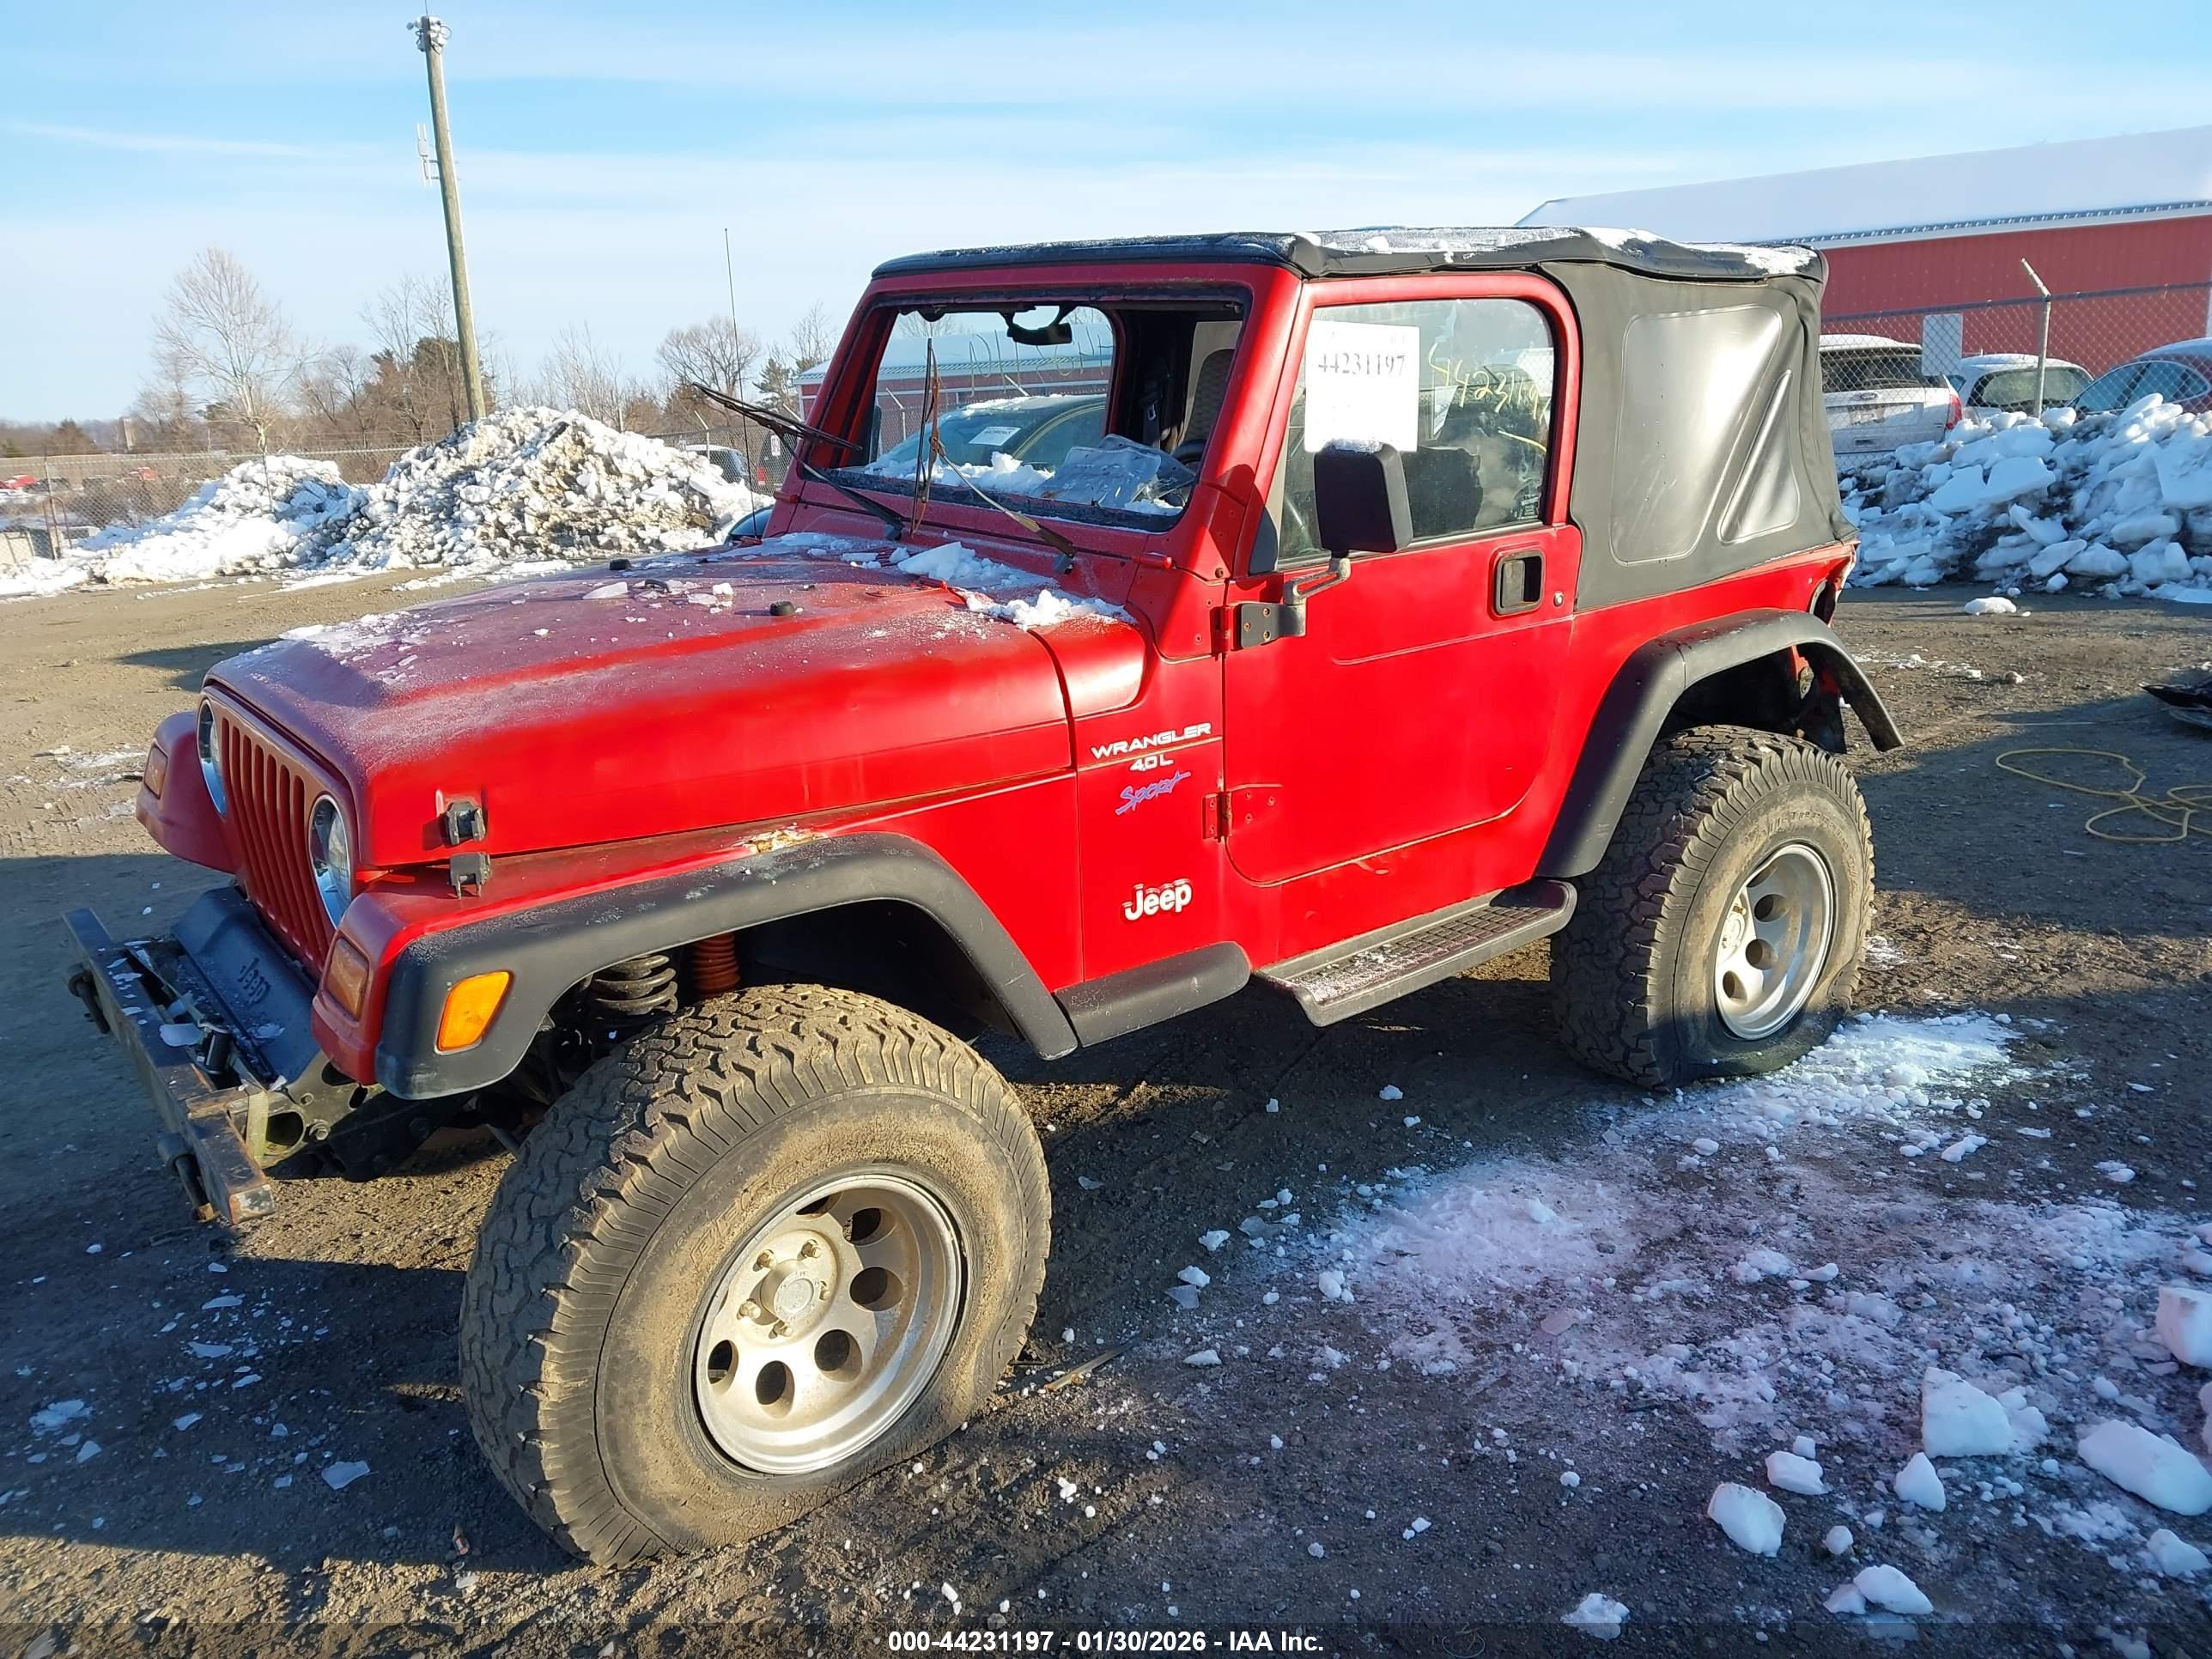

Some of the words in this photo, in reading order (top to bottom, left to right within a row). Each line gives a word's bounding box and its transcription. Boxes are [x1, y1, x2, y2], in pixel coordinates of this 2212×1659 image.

[1317, 352, 1406, 375] 44231197
[1091, 722, 1212, 759] WRANGLER
[1115, 769, 1192, 816] Sport
[1121, 878, 1194, 921] Jeep
[237, 957, 271, 1005] Jeep
